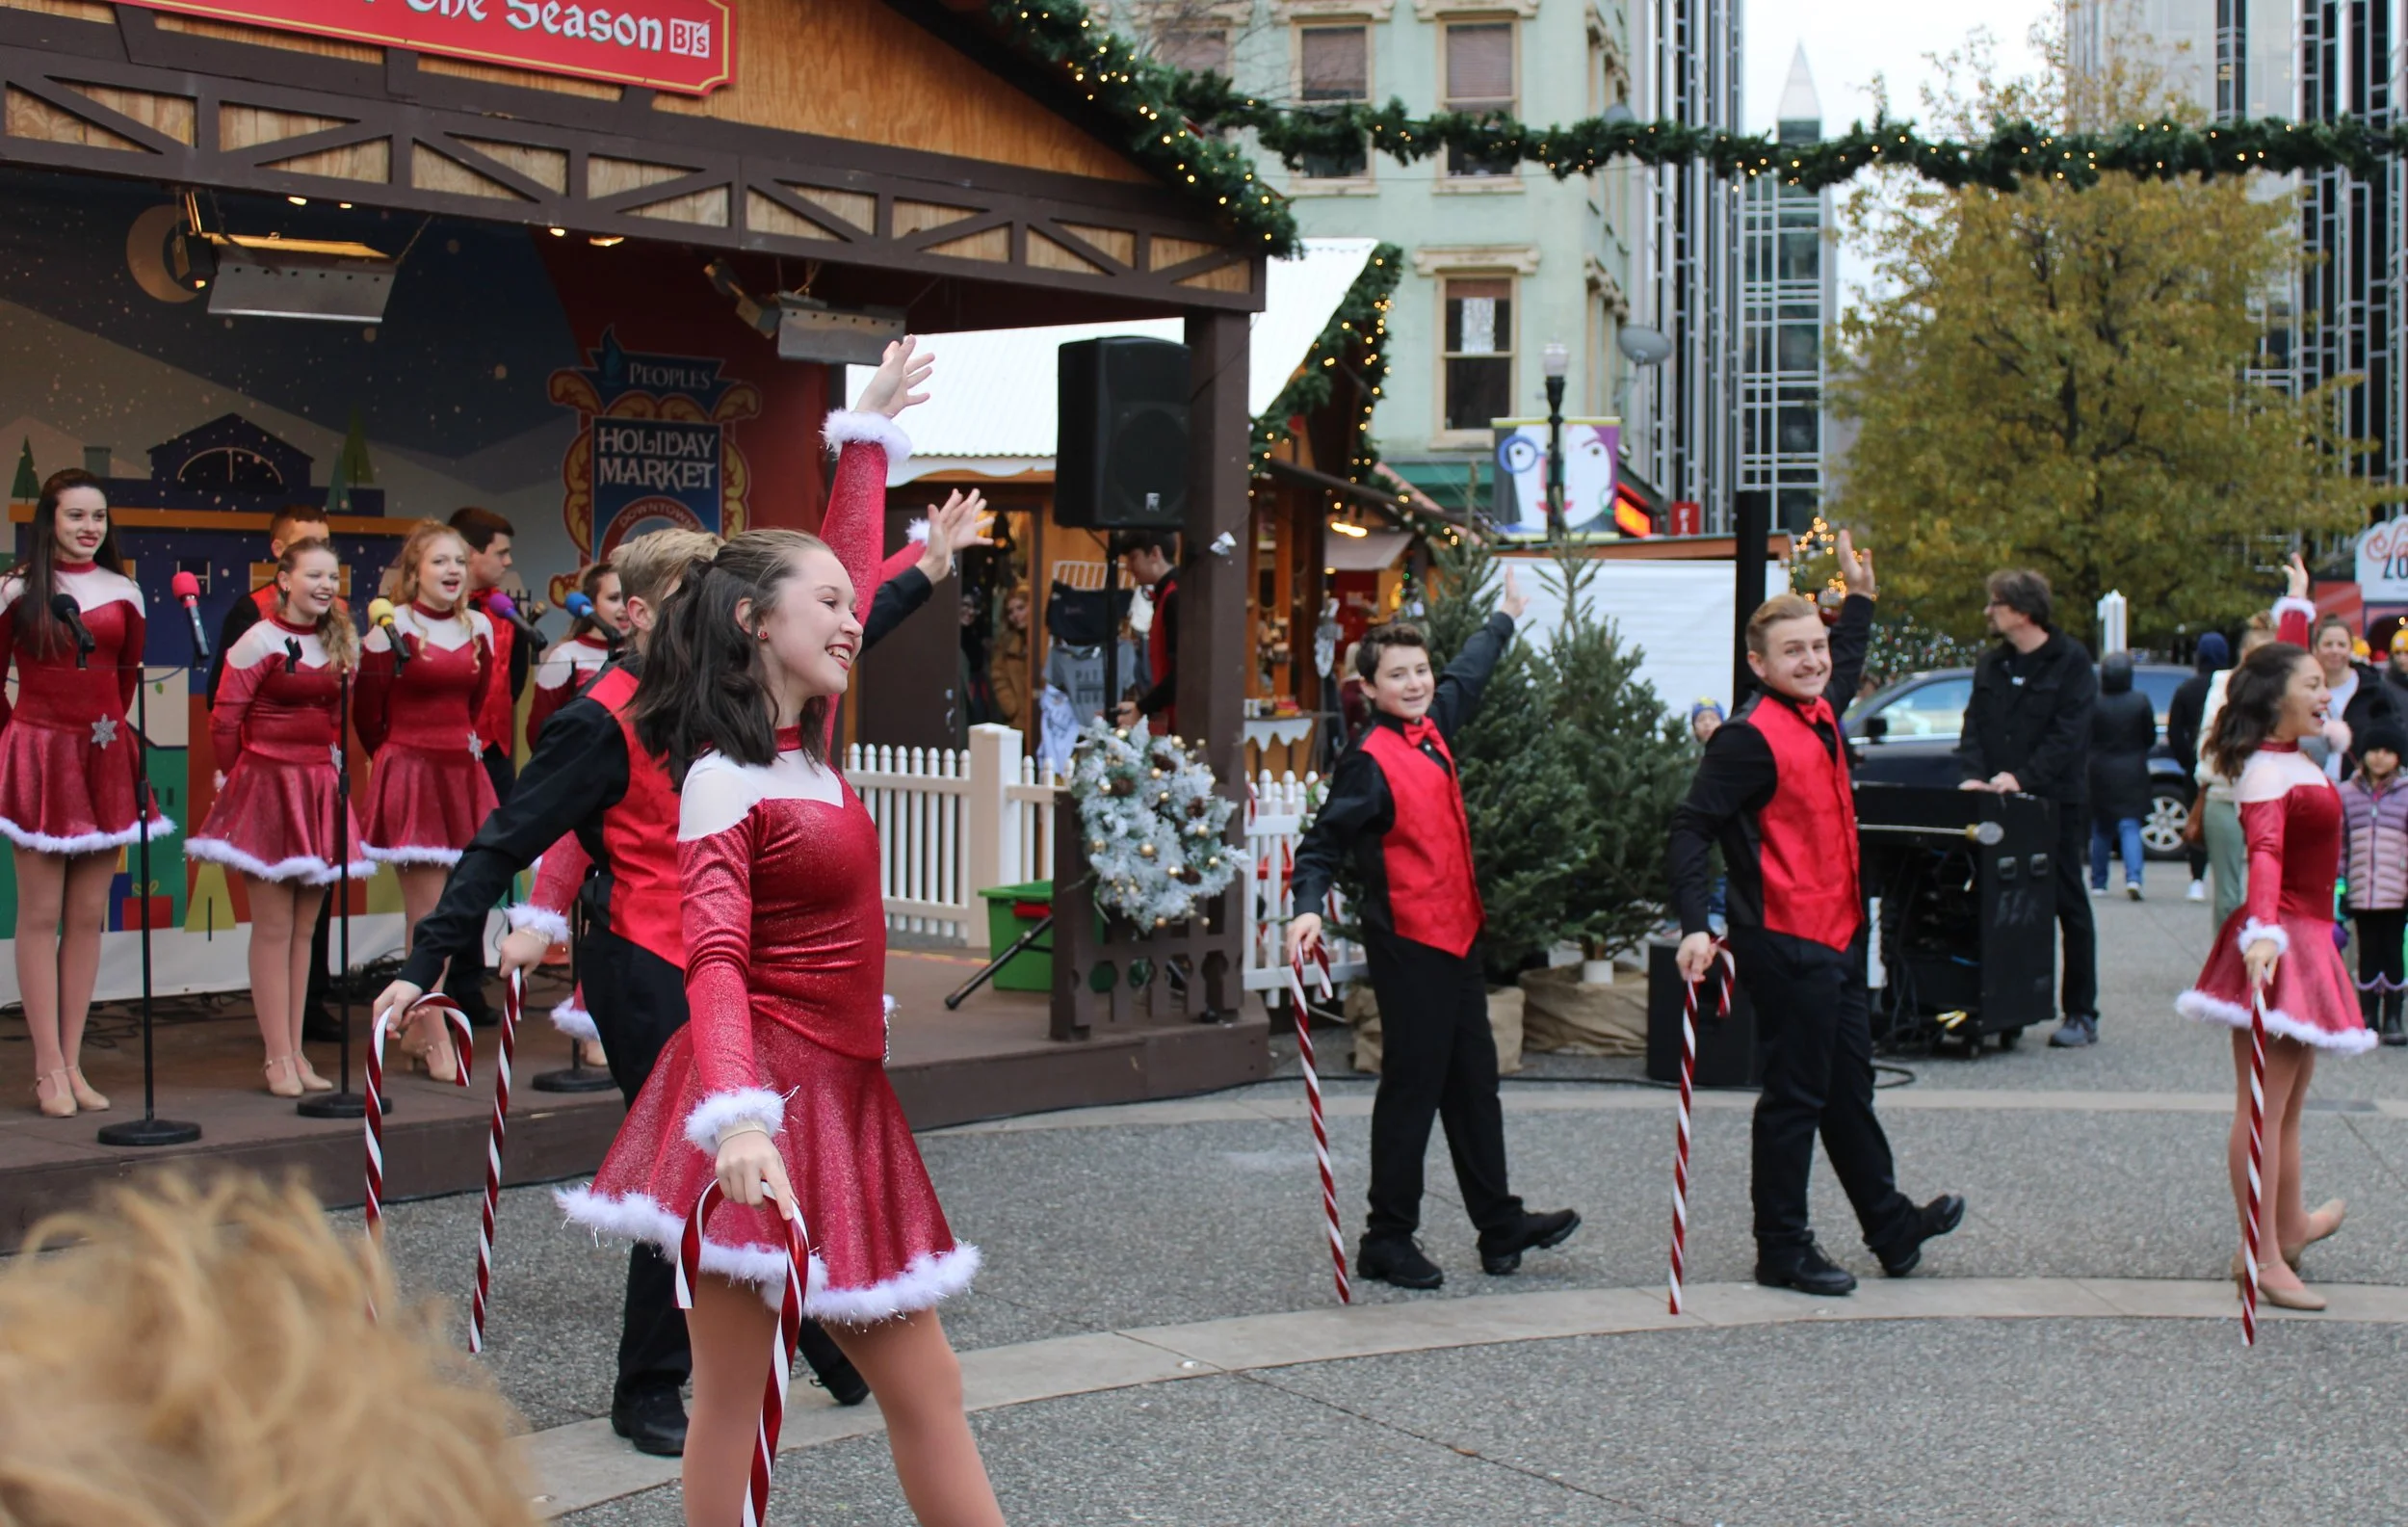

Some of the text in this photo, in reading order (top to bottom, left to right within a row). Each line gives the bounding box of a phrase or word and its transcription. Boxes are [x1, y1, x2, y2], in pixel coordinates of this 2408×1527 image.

[505, 0, 664, 52] Season
[629, 362, 711, 389] PEOPLES
[597, 427, 715, 460] HOLIDAY
[599, 459, 716, 492] MARKET
